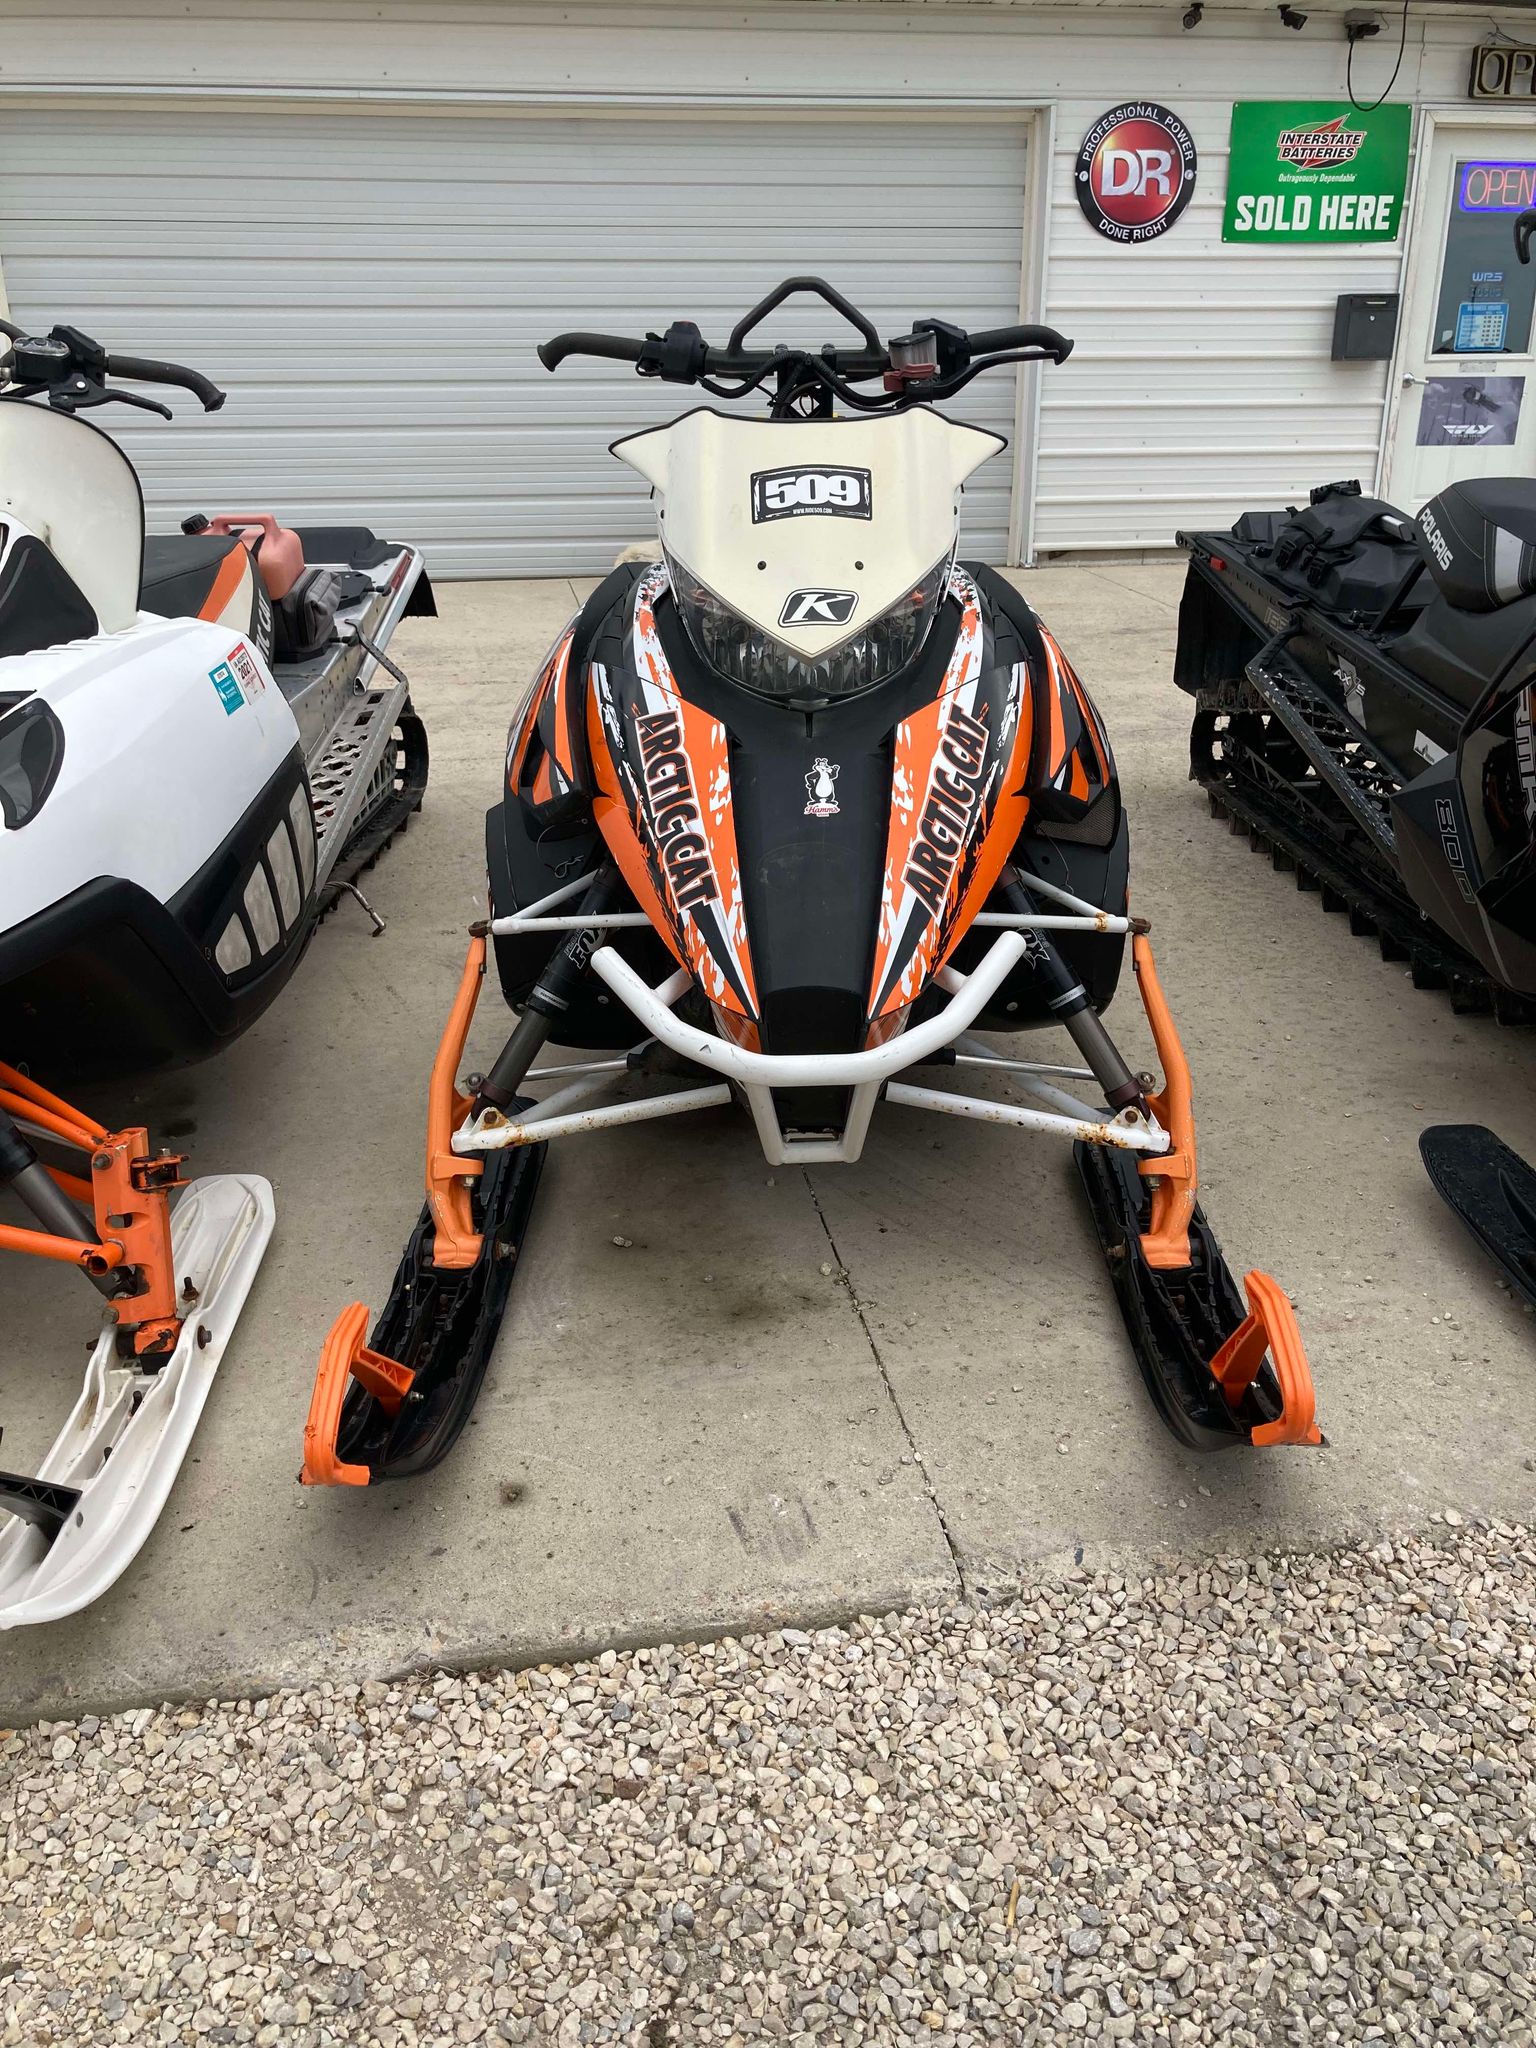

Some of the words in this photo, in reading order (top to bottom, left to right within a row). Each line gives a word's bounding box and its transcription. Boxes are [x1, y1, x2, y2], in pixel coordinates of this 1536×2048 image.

[1479, 50, 1536, 96] OP
[1082, 105, 1159, 161] PROFESSIONAL
[1164, 115, 1194, 161] POWER
[1280, 133, 1362, 145] INTERSTATE
[1281, 147, 1355, 159] BATTERIES
[1100, 149, 1172, 196] DR
[1278, 173, 1318, 184] Outrageously
[1467, 168, 1536, 206] OPEN
[1098, 219, 1131, 240] DONE
[1133, 217, 1168, 240] RIGHT
[1234, 195, 1312, 231] SOLD
[1318, 195, 1395, 231] HERE
[1472, 272, 1504, 282] WPS
[1442, 425, 1495, 435] FLY
[765, 474, 861, 509] 509
[1418, 507, 1454, 571] POLARIS
[784, 593, 853, 623] K
[237, 659, 253, 680] 2021
[639, 710, 700, 838] ARCTIC
[902, 764, 976, 918] ARCTIC
[940, 702, 989, 779] CAT
[1435, 798, 1476, 905] 800
[663, 833, 722, 912] CAT
